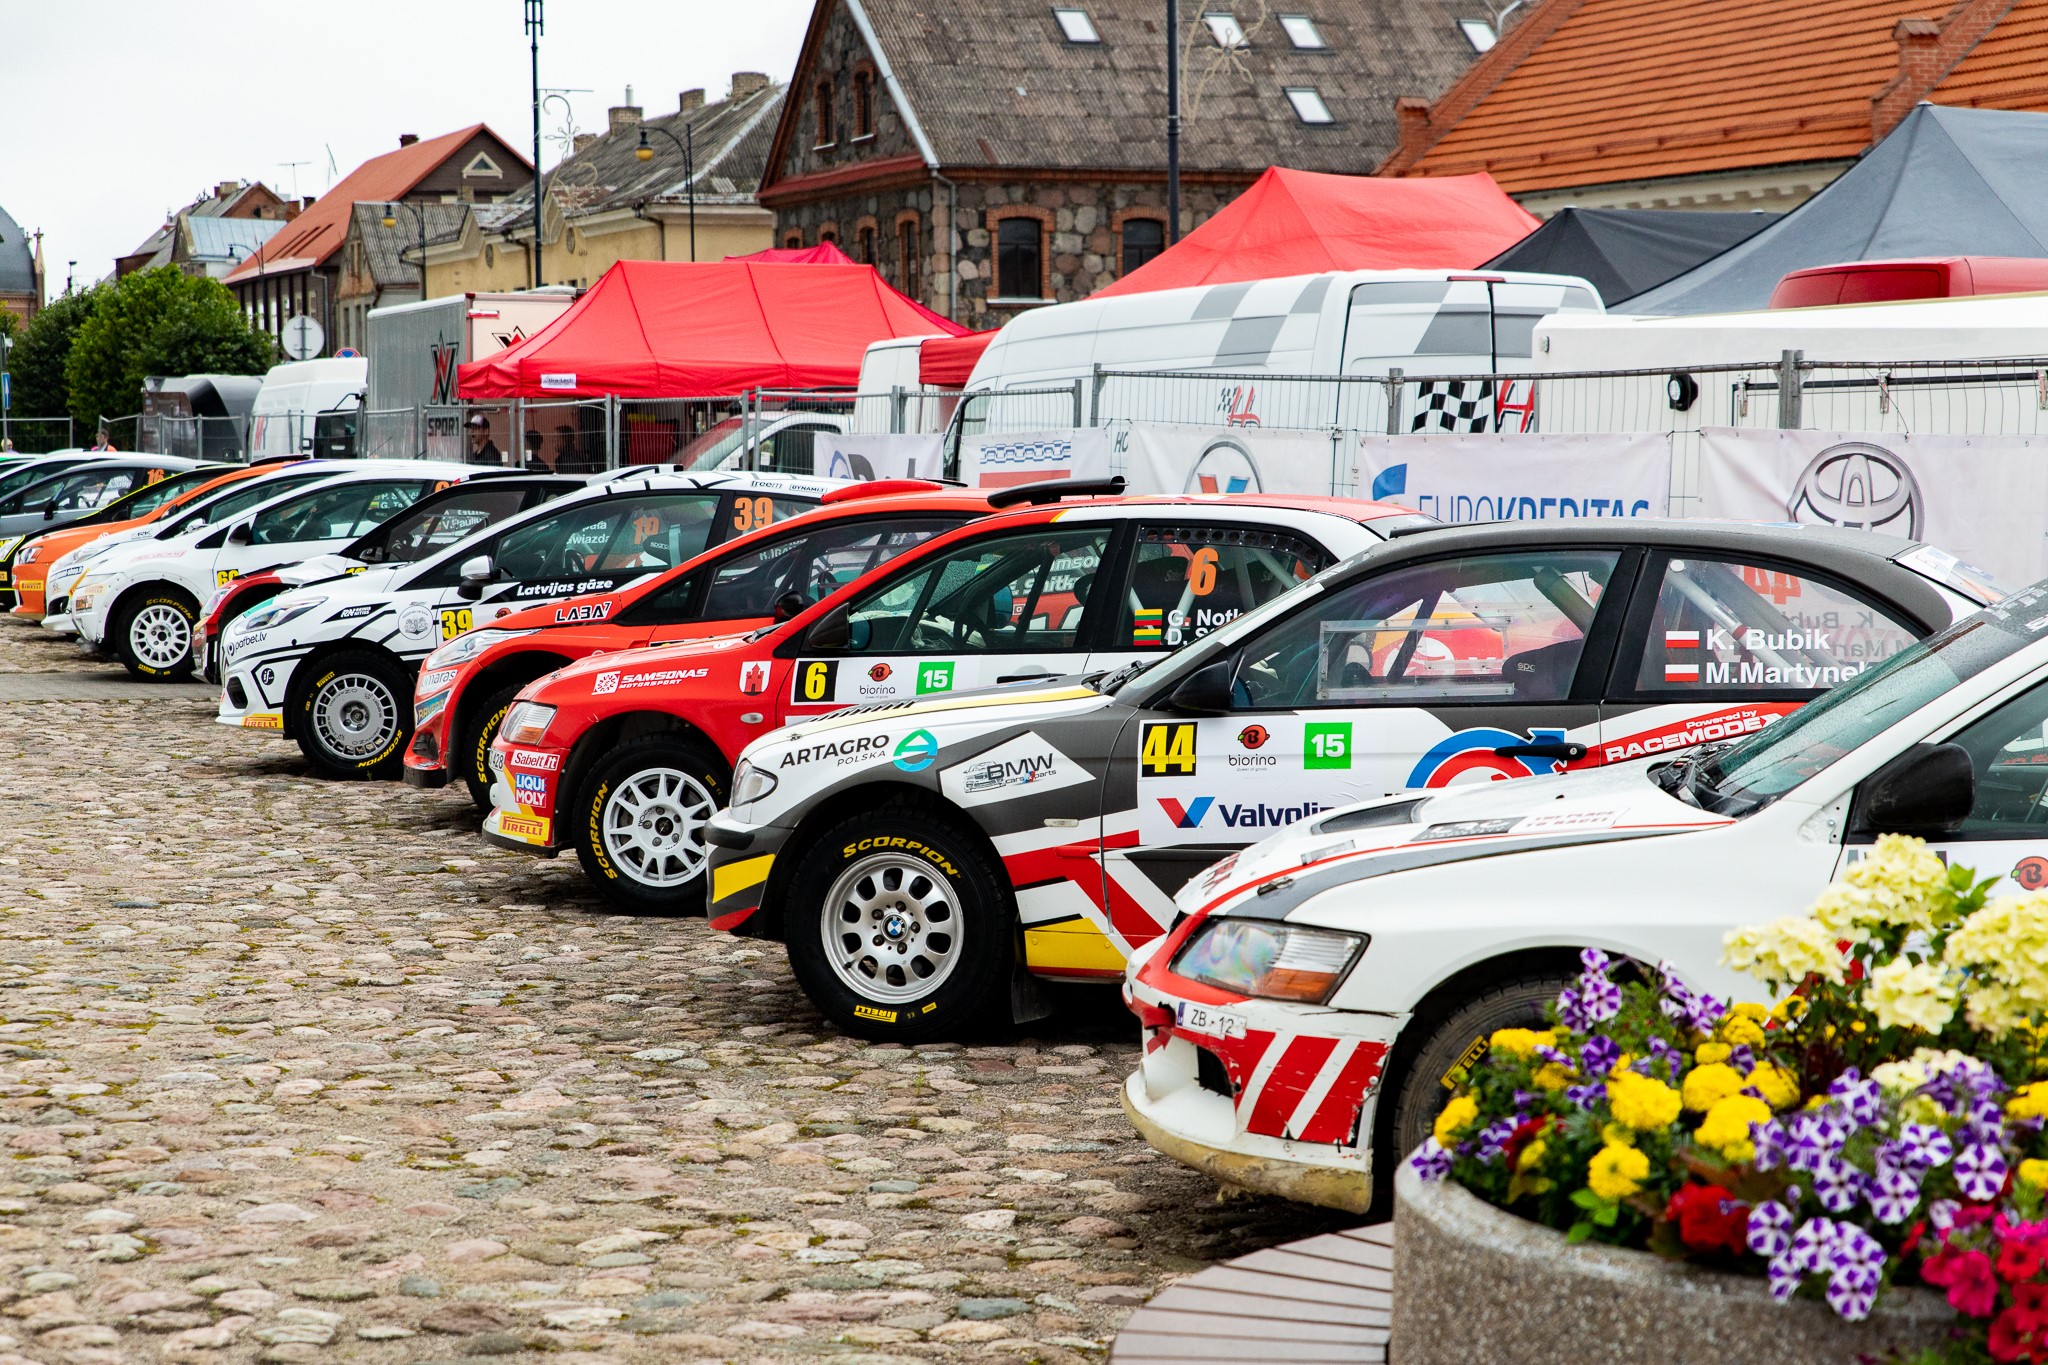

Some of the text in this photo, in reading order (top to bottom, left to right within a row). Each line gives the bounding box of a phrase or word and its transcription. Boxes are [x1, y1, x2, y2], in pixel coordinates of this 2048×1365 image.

[733, 497, 774, 531] 39
[1189, 547, 1219, 596] 6
[516, 582, 575, 597] Latvijas
[146, 598, 193, 620] SCORPION
[1167, 609, 1190, 627] G.
[441, 609, 474, 640] 39
[1167, 628, 1188, 646] D.
[1706, 628, 1831, 651] K. Bubik
[618, 678, 683, 689] MOTORSPORT
[621, 668, 710, 684] SAMSONAS
[804, 661, 828, 700] 6
[922, 669, 949, 689] 15
[859, 684, 896, 695] biorina
[243, 716, 278, 728] PIRELLI
[1685, 710, 1758, 730] Powered by
[356, 729, 403, 768] SCORPION
[476, 704, 511, 783] SCORPION
[779, 734, 890, 769] ARTAGRO
[1142, 724, 1196, 773] 44
[1310, 733, 1346, 758] 15
[837, 750, 886, 767] POLSKA
[986, 753, 1053, 781] BMW
[1228, 754, 1277, 767] biorina
[515, 774, 546, 792] LIQUI
[1005, 776, 1024, 784] cars
[1034, 769, 1057, 780] parts
[515, 790, 547, 806] MOLY
[502, 815, 544, 836] PIRELLI
[589, 781, 619, 880] SCORPION
[843, 836, 958, 877] SCORPION
[853, 1004, 898, 1023] PIRELLI
